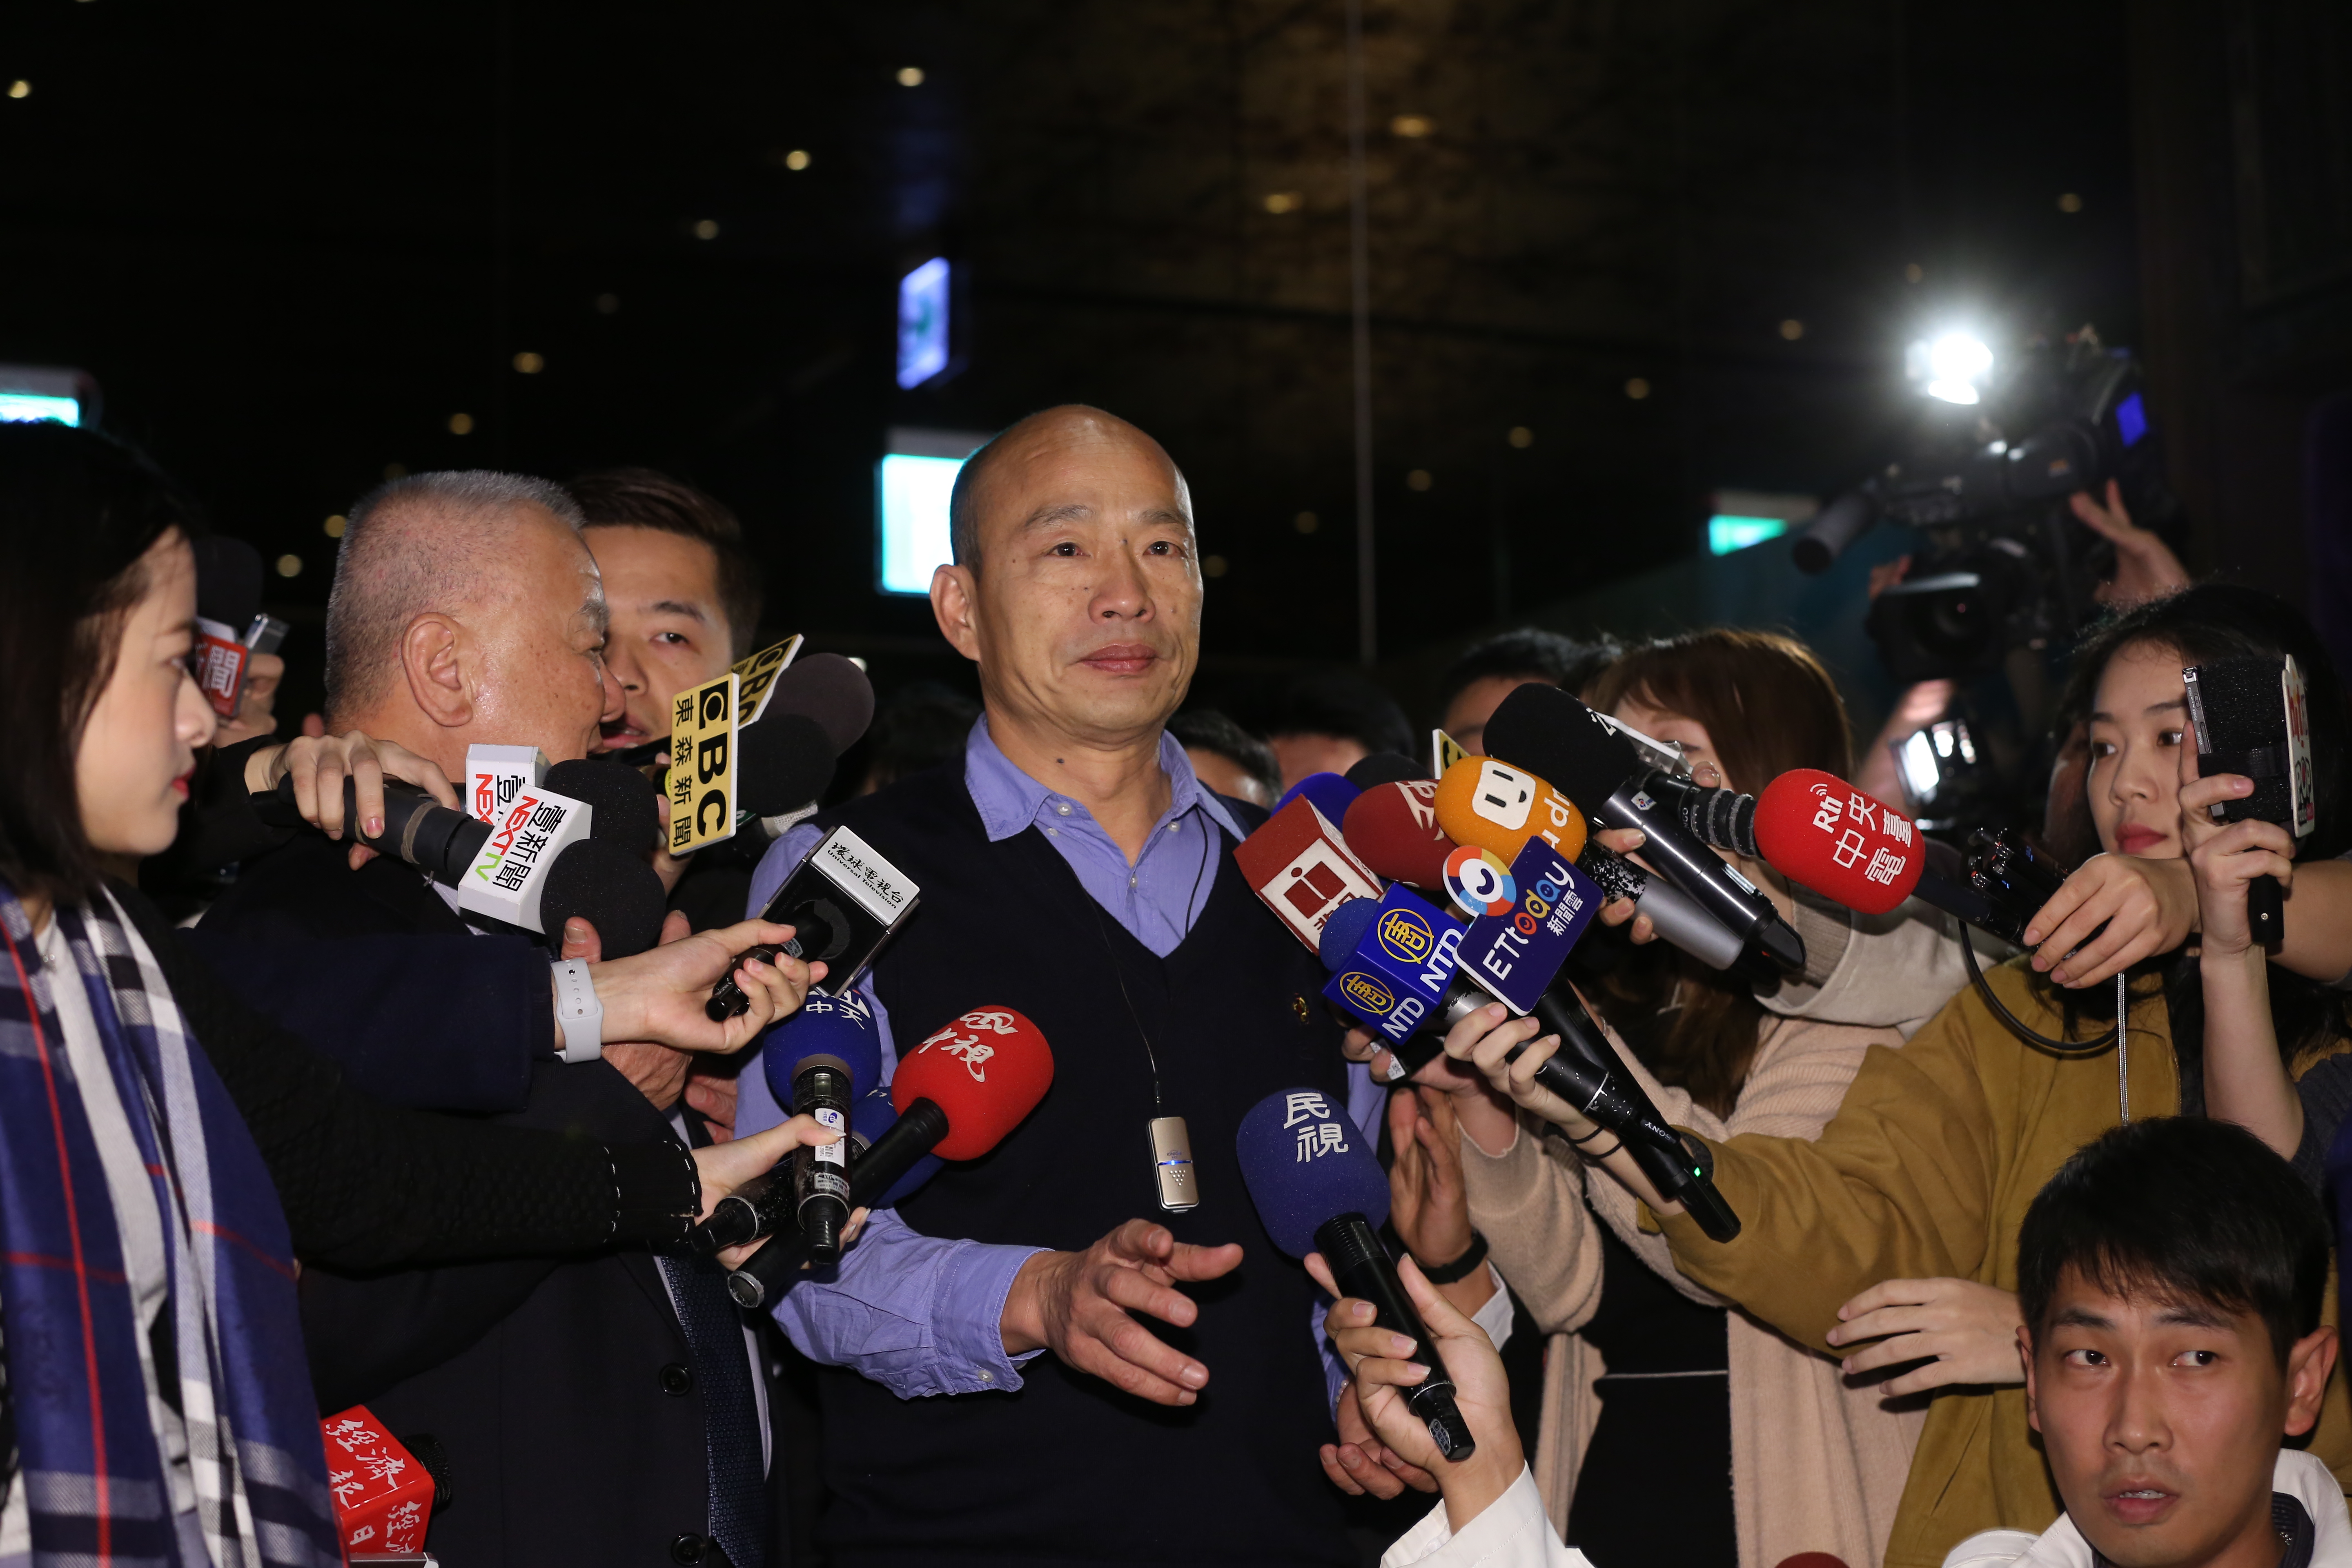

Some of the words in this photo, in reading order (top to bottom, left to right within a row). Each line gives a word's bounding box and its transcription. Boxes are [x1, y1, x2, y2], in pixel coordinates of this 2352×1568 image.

[673, 695, 693, 847] 東森新聞
[492, 801, 567, 892] 壹新聞
[1832, 792, 1877, 869] 中央
[827, 850, 861, 878] Universal
[862, 878, 897, 909] Television
[1546, 889, 1584, 936] 新聞雲
[1482, 861, 1575, 981] ETtoday
[1419, 928, 1463, 993] NTD
[1381, 997, 1425, 1039] NTD
[1283, 1092, 1349, 1163] 民視
[1644, 1121, 1672, 1140] SONY
